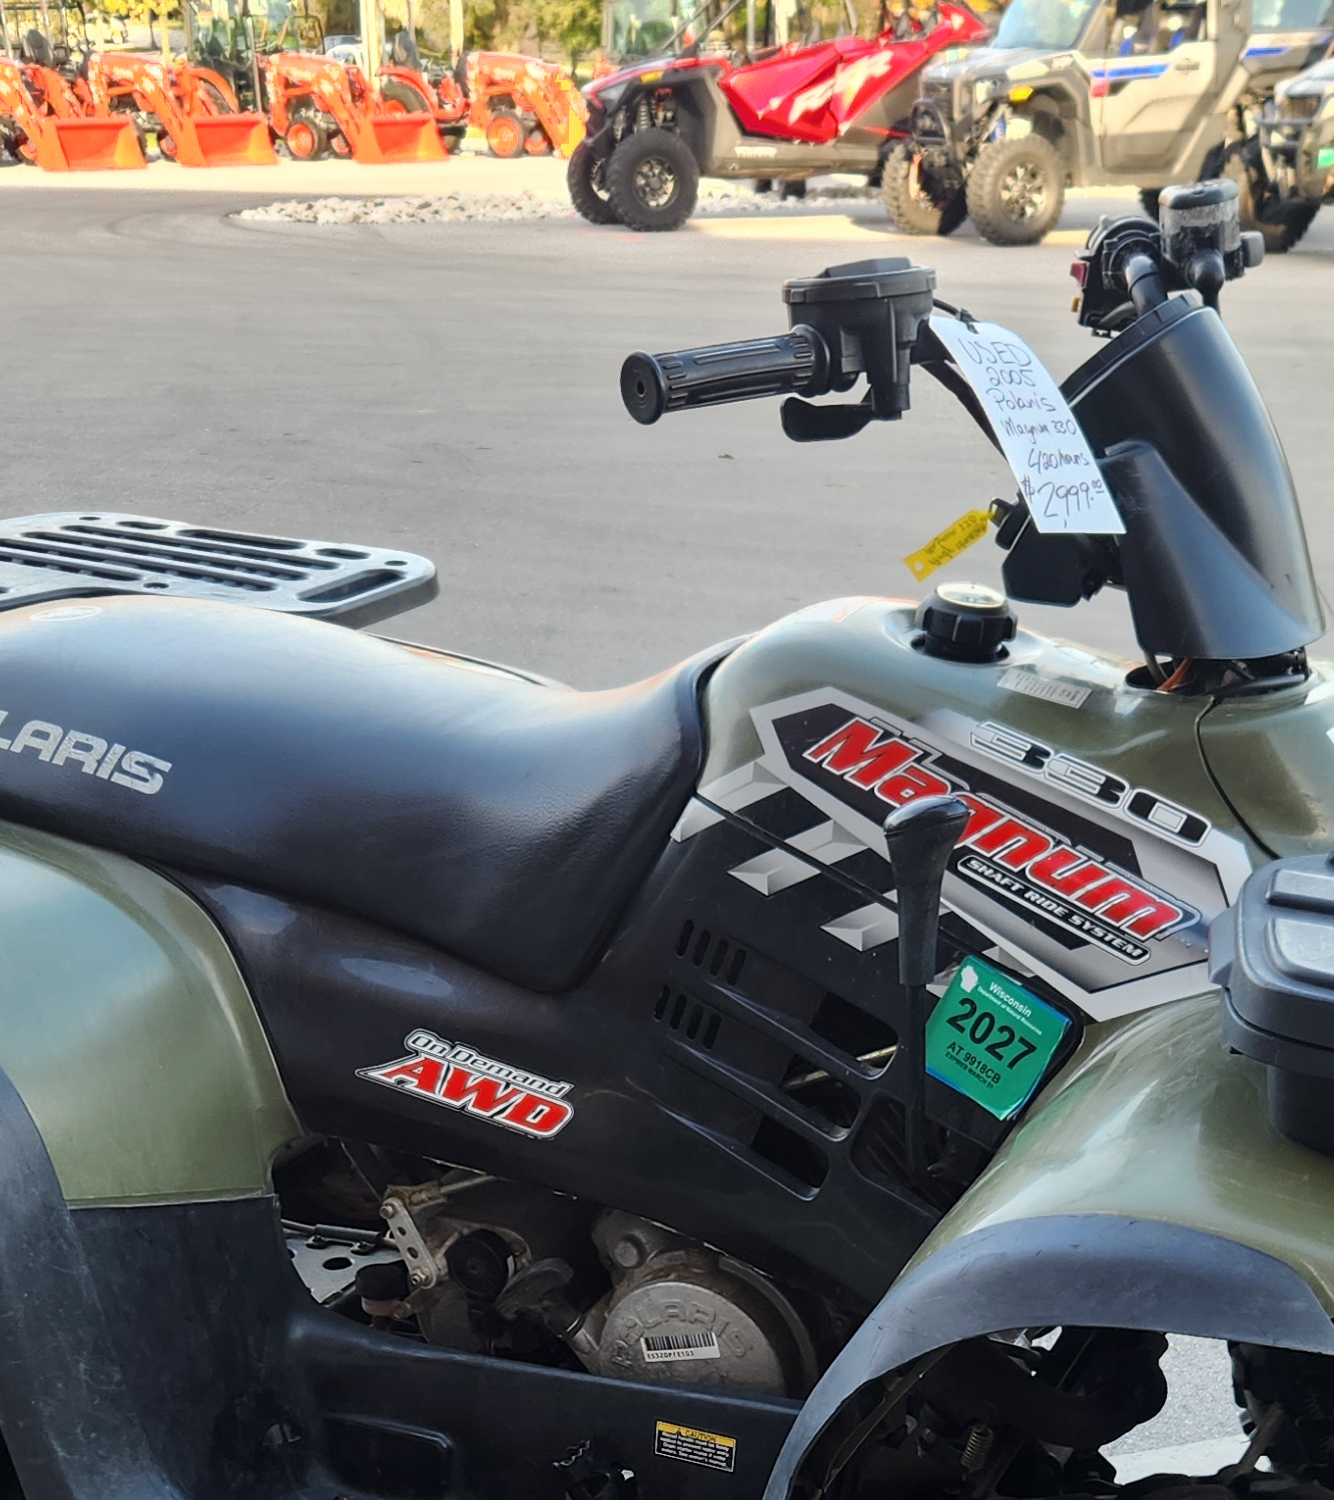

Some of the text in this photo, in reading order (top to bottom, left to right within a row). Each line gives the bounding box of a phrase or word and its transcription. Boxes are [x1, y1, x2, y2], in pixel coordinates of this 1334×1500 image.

[958, 337, 1032, 367] USED
[986, 369, 1036, 388] 2005
[986, 388, 1057, 412] Polaris
[1052, 419, 1077, 435] 330
[969, 720, 1212, 848] 330
[967, 859, 1143, 958] SHAFT RIDE SYSTEM
[989, 981, 1033, 1018] Wisconsin
[946, 997, 1038, 1070] 2027
[410, 1034, 569, 1097] On Demand
[947, 1041, 1002, 1085] AT 9918CB
[967, 1066, 988, 1085] MARCH
[374, 1055, 572, 1136] AWD
[685, 1429, 716, 1443] CAUTION
